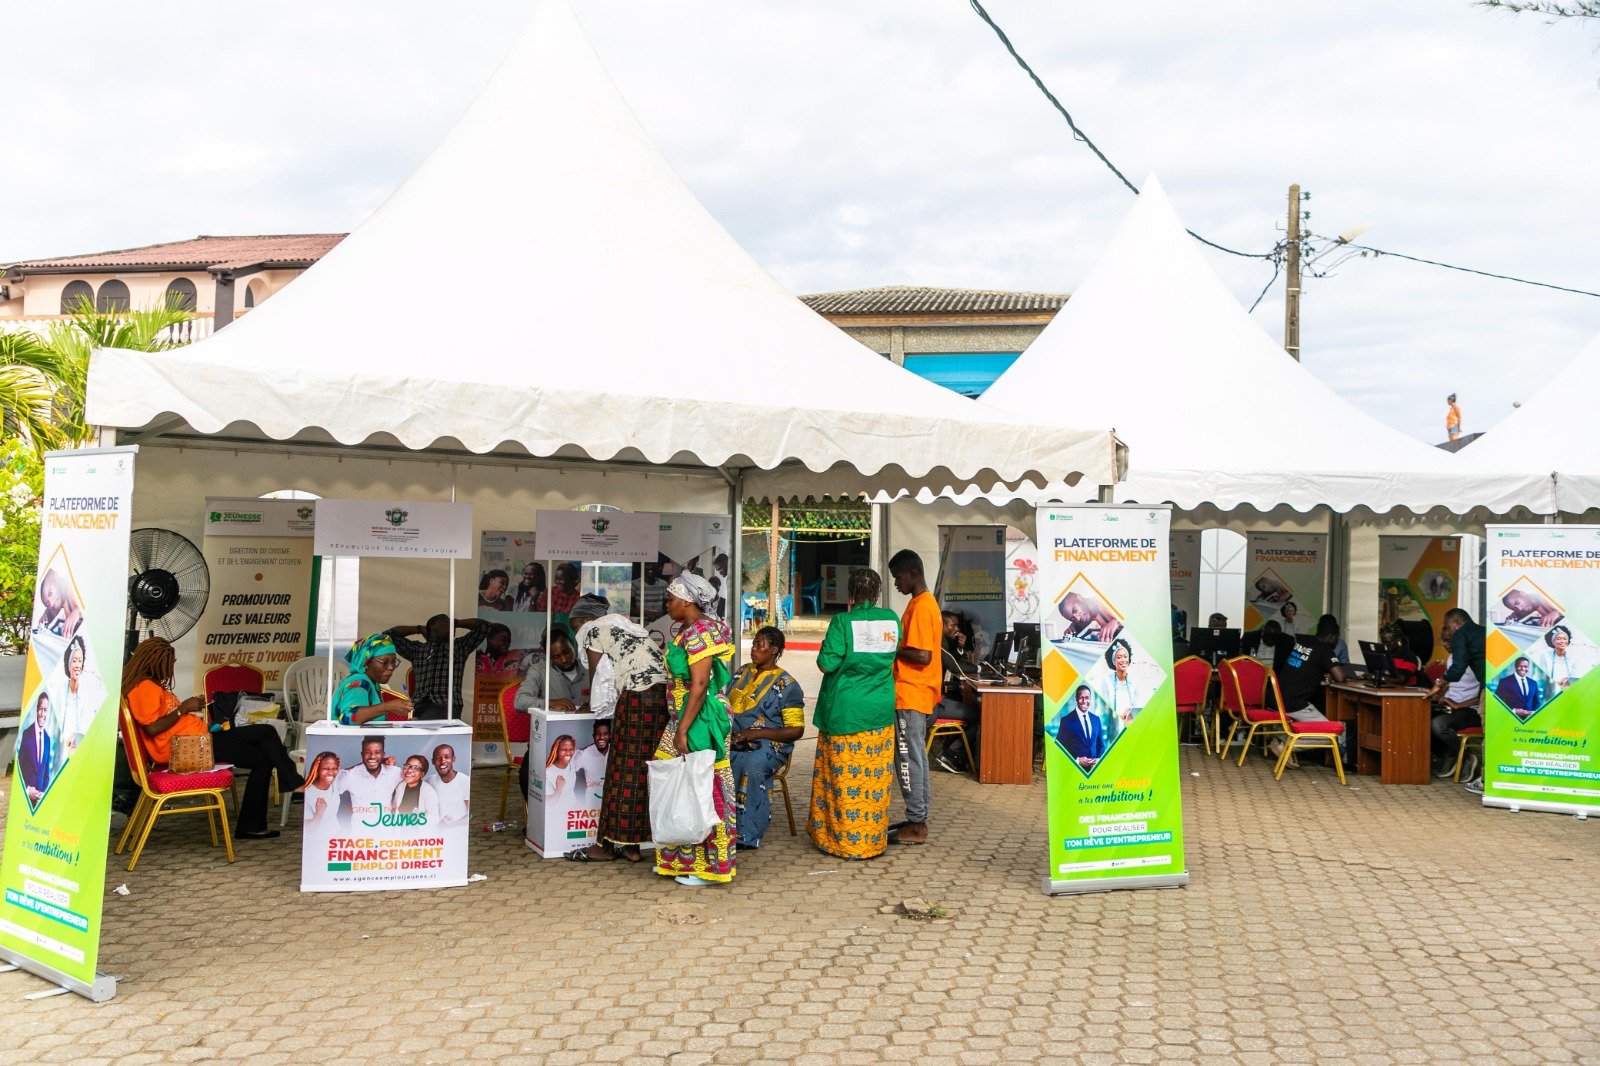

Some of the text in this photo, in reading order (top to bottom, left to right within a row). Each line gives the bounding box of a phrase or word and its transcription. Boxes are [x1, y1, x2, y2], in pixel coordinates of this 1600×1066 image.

[50, 497, 119, 510] PLATEFORME DE
[47, 513, 118, 529] FINANCEMENT
[1054, 538, 1156, 548] PLATEFORME DE
[229, 547, 290, 555] DIRECTION DU CIVISME
[1054, 549, 1157, 562] FINANCEMENT
[1501, 549, 1600, 559] PLATEFORME DE
[218, 557, 226, 565] ET
[226, 557, 234, 565] DE
[278, 558, 302, 566] CITOYEN
[1255, 555, 1318, 563] FINANCEMENT
[222, 594, 291, 606] PROMOUVOIR
[222, 613, 291, 625] LES VALEURS
[205, 632, 301, 645] CITOYENNES POUR
[203, 649, 302, 664] UNE CÔTE D'IVOIRE
[477, 703, 486, 713] JE
[1528, 736, 1578, 748] ambitions
[1529, 751, 1591, 762] FINANCEMENTS
[1516, 766, 1536, 774] RÊVE
[1094, 790, 1145, 804] ambitions
[362, 802, 428, 827] Jeunes
[1079, 815, 1095, 824] DES
[1092, 825, 1112, 834] POUR
[379, 838, 444, 848] FORMATION
[1065, 832, 1171, 848] TON RÊVE D'ENTREPRENEUR
[33, 840, 73, 865] ambitions
[327, 847, 443, 861] FINANCEMENT
[352, 859, 444, 871] EMPLOI DIRECT
[333, 874, 437, 882] www.agenceemploijeunes.ci
